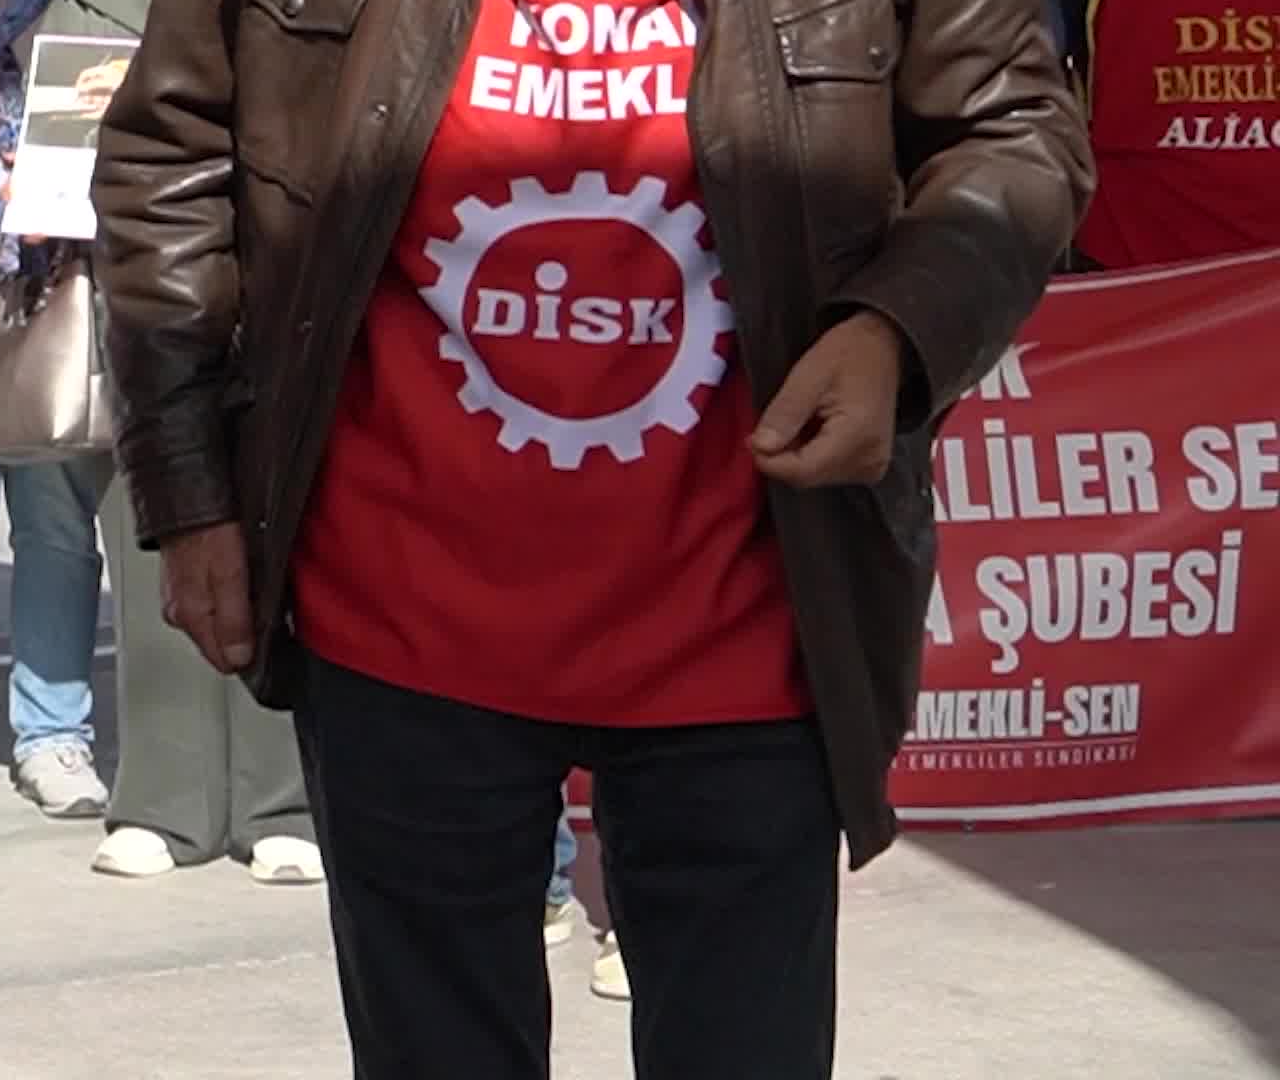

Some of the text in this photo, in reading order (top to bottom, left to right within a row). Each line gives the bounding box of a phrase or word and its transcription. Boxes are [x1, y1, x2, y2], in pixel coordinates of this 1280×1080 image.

[1175, 8, 1280, 54] DİS
[471, 260, 674, 345] DİSK
[975, 529, 1243, 675] ŞUBESİ
[904, 677, 1140, 741] MEKLİ-SEN
